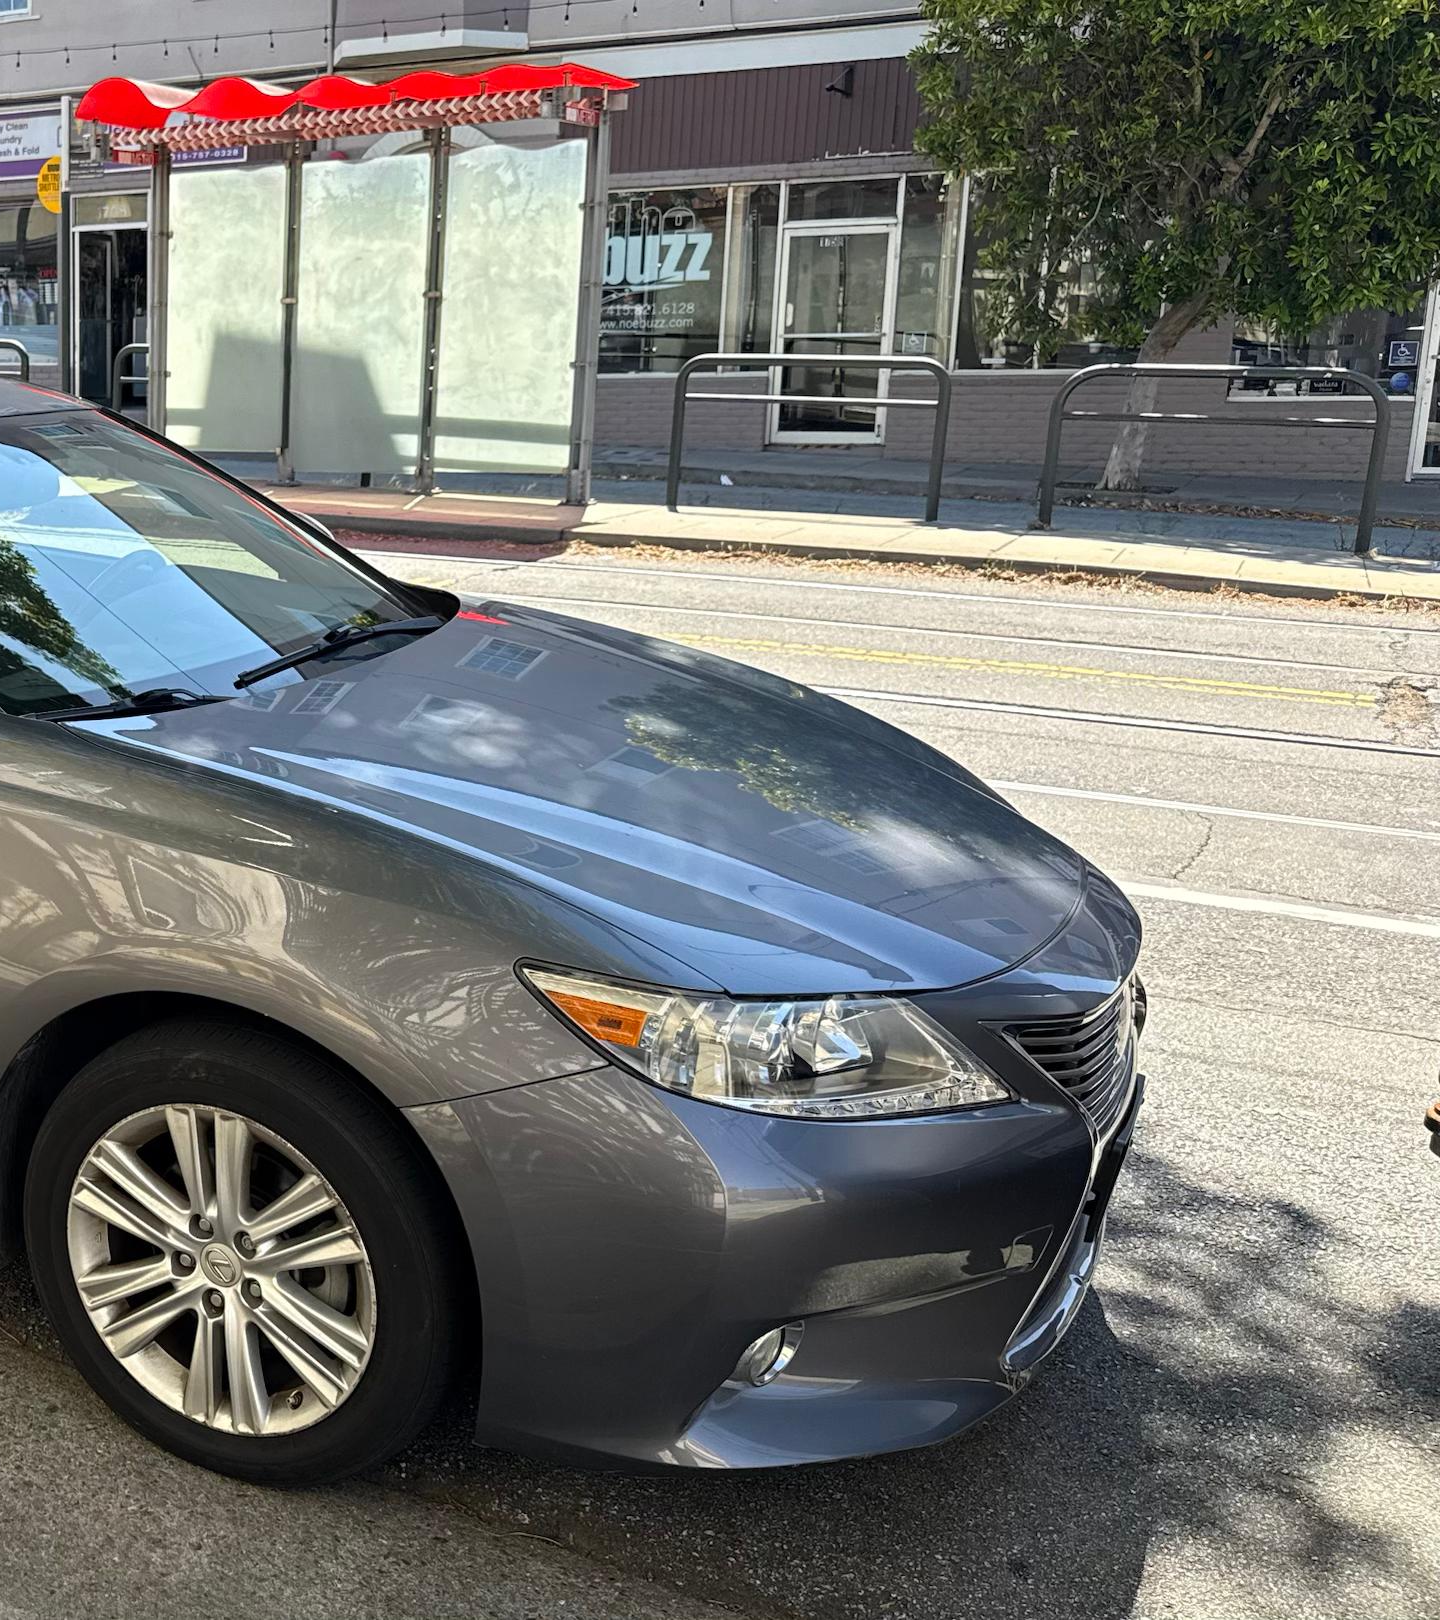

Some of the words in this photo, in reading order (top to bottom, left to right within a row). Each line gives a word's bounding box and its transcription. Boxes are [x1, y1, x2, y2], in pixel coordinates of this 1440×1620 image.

[5, 123, 28, 131] Clean
[14, 148, 20, 156] &
[22, 147, 40, 155] Fold
[602, 227, 713, 286] buzz
[600, 318, 694, 329] ww.noebuzz.com
